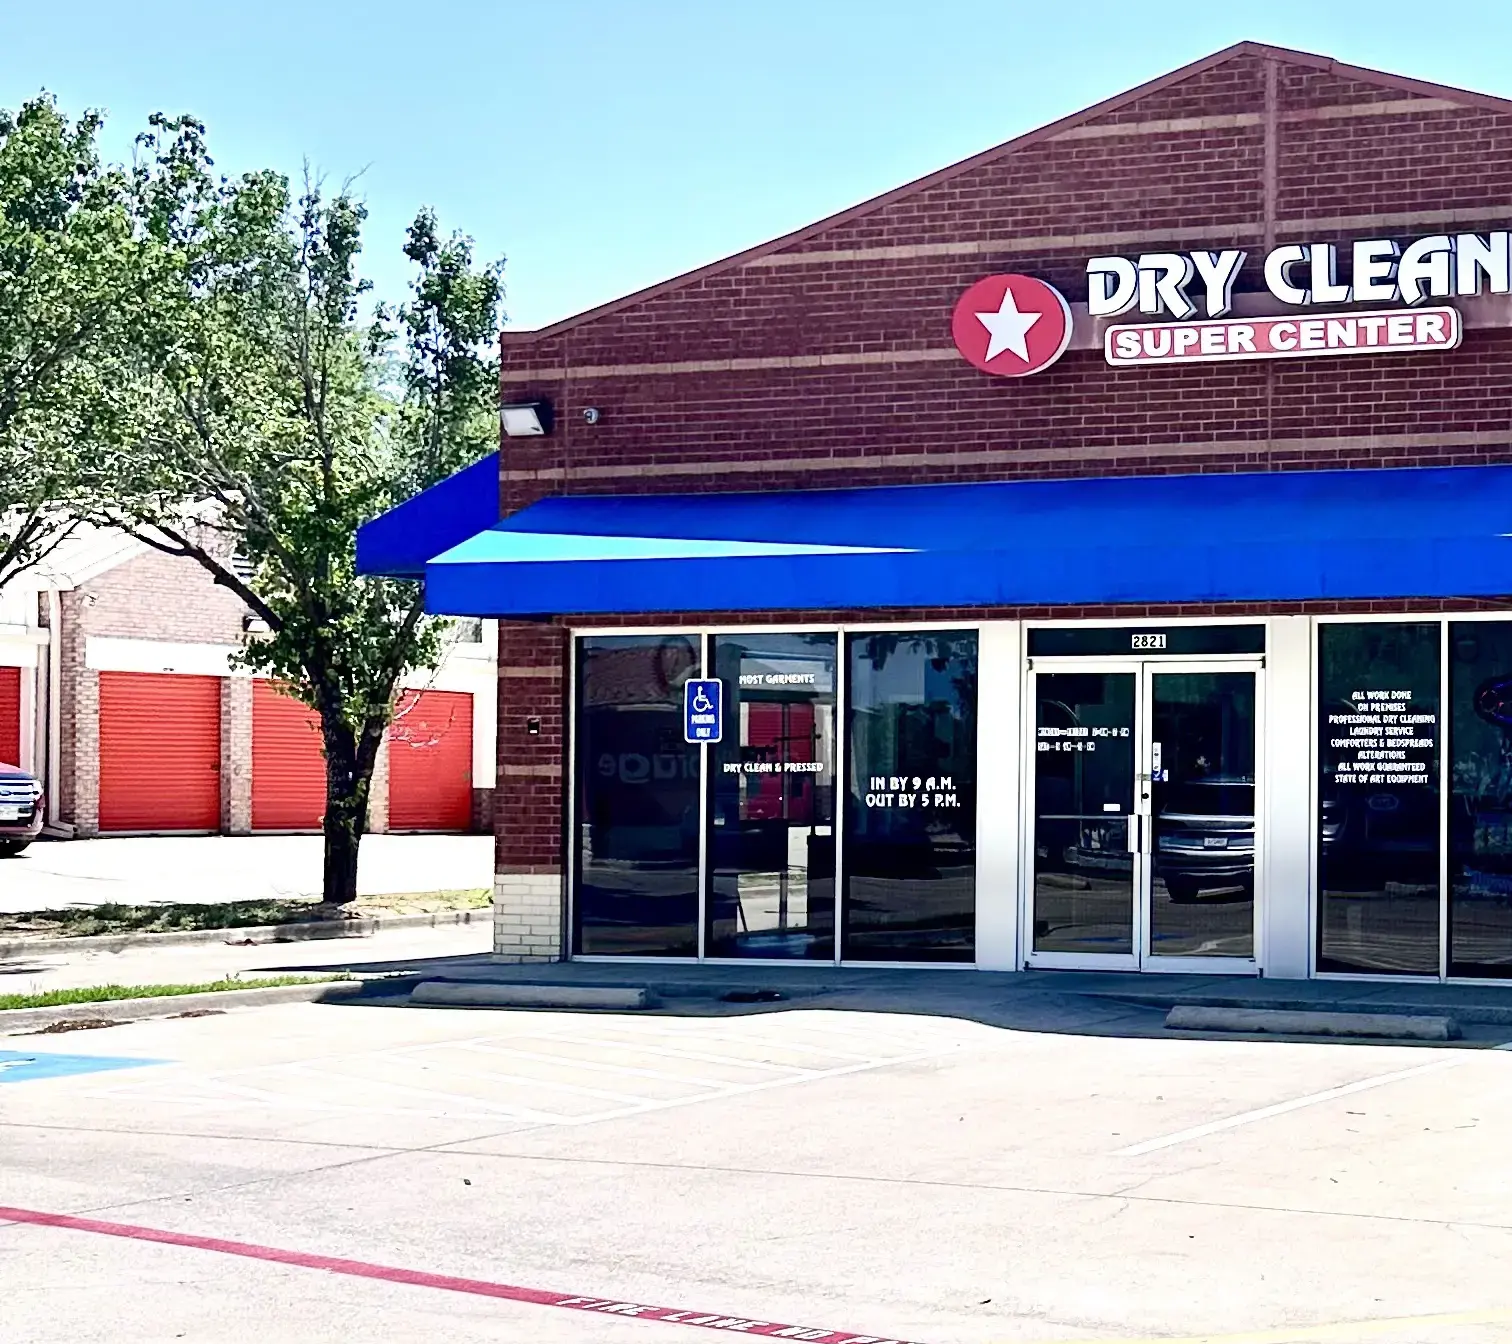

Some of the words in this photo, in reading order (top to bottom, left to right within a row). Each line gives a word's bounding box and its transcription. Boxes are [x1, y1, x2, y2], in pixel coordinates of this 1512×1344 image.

[1086, 250, 1247, 319] DRY
[1116, 323, 1257, 358] SUPER
[1268, 314, 1447, 351] CENTER
[1133, 635, 1164, 648] 2821
[739, 674, 763, 684] MOST
[765, 674, 815, 684] GARMENTS
[1352, 691, 1365, 700] ALL
[1367, 691, 1389, 700] WORK
[1391, 691, 1412, 700] DONE
[1358, 703, 1368, 712] ON
[1370, 703, 1406, 712] PREMISES
[1328, 715, 1381, 724] PROFESSIONAL
[1383, 715, 1398, 724] DRY
[1400, 715, 1436, 724] CLEANING
[1350, 727, 1383, 736] LAUNDRY
[1385, 727, 1414, 736] SERVICE
[1331, 739, 1377, 748] COMFORTERS
[1379, 739, 1385, 748] &
[1387, 739, 1433, 748] BEDSPREADS
[724, 763, 741, 773] DRY
[743, 763, 773, 773] CLEAN
[774, 763, 782, 773] &
[784, 763, 823, 773] PRESSED
[1338, 763, 1351, 772] ALL
[1353, 763, 1375, 772] WORK
[870, 776, 886, 791] IN
[889, 776, 909, 792] BY
[911, 776, 922, 791] 9
[925, 776, 957, 792] A.M.
[1335, 775, 1357, 784] STATE
[1358, 775, 1368, 784] OF
[1370, 775, 1385, 784] ART
[865, 793, 895, 808] OUT
[898, 793, 917, 809] BY
[921, 793, 930, 808] 5
[934, 793, 961, 808] P.M.
[556, 1296, 659, 1316] FIRE
[661, 1311, 770, 1333] LANE
[770, 1324, 835, 1341] NO
